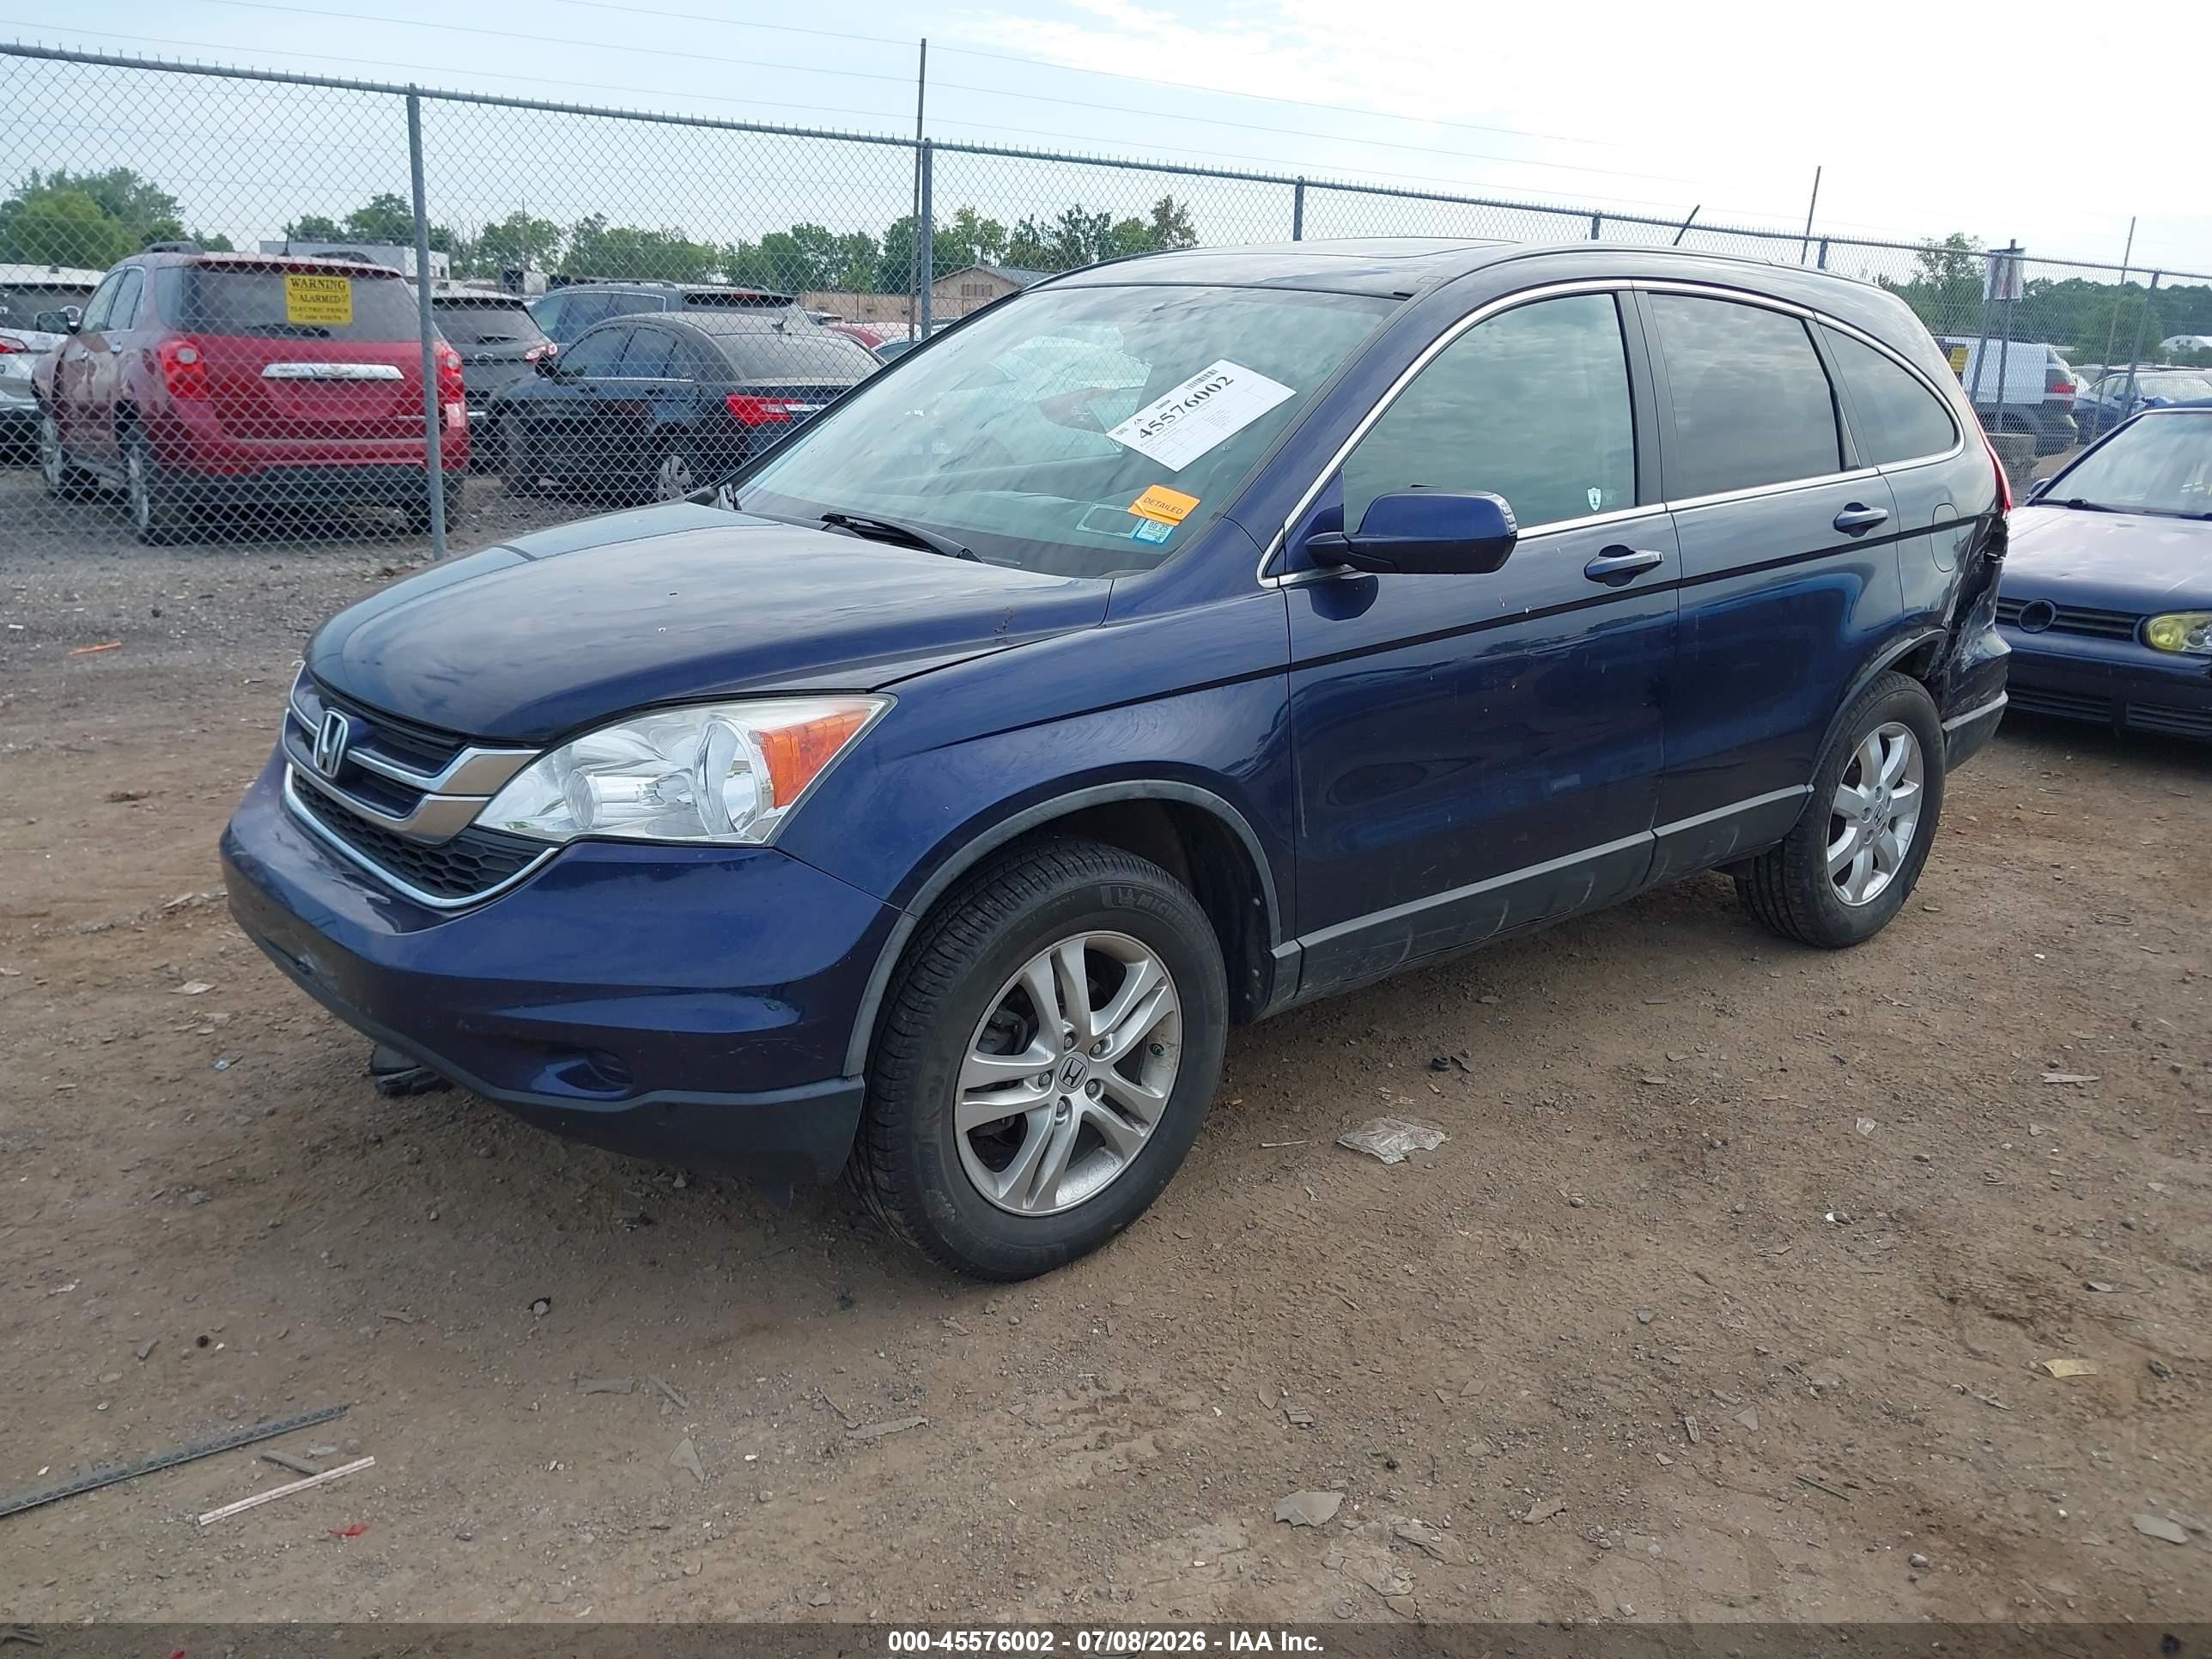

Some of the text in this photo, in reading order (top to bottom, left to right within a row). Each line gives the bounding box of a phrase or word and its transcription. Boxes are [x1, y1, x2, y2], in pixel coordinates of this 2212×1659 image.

[290, 277, 346, 290] WARNING
[300, 294, 341, 304] ALARMED
[1139, 375, 1235, 439] 45576002
[1143, 496, 1184, 515] DETAILED
